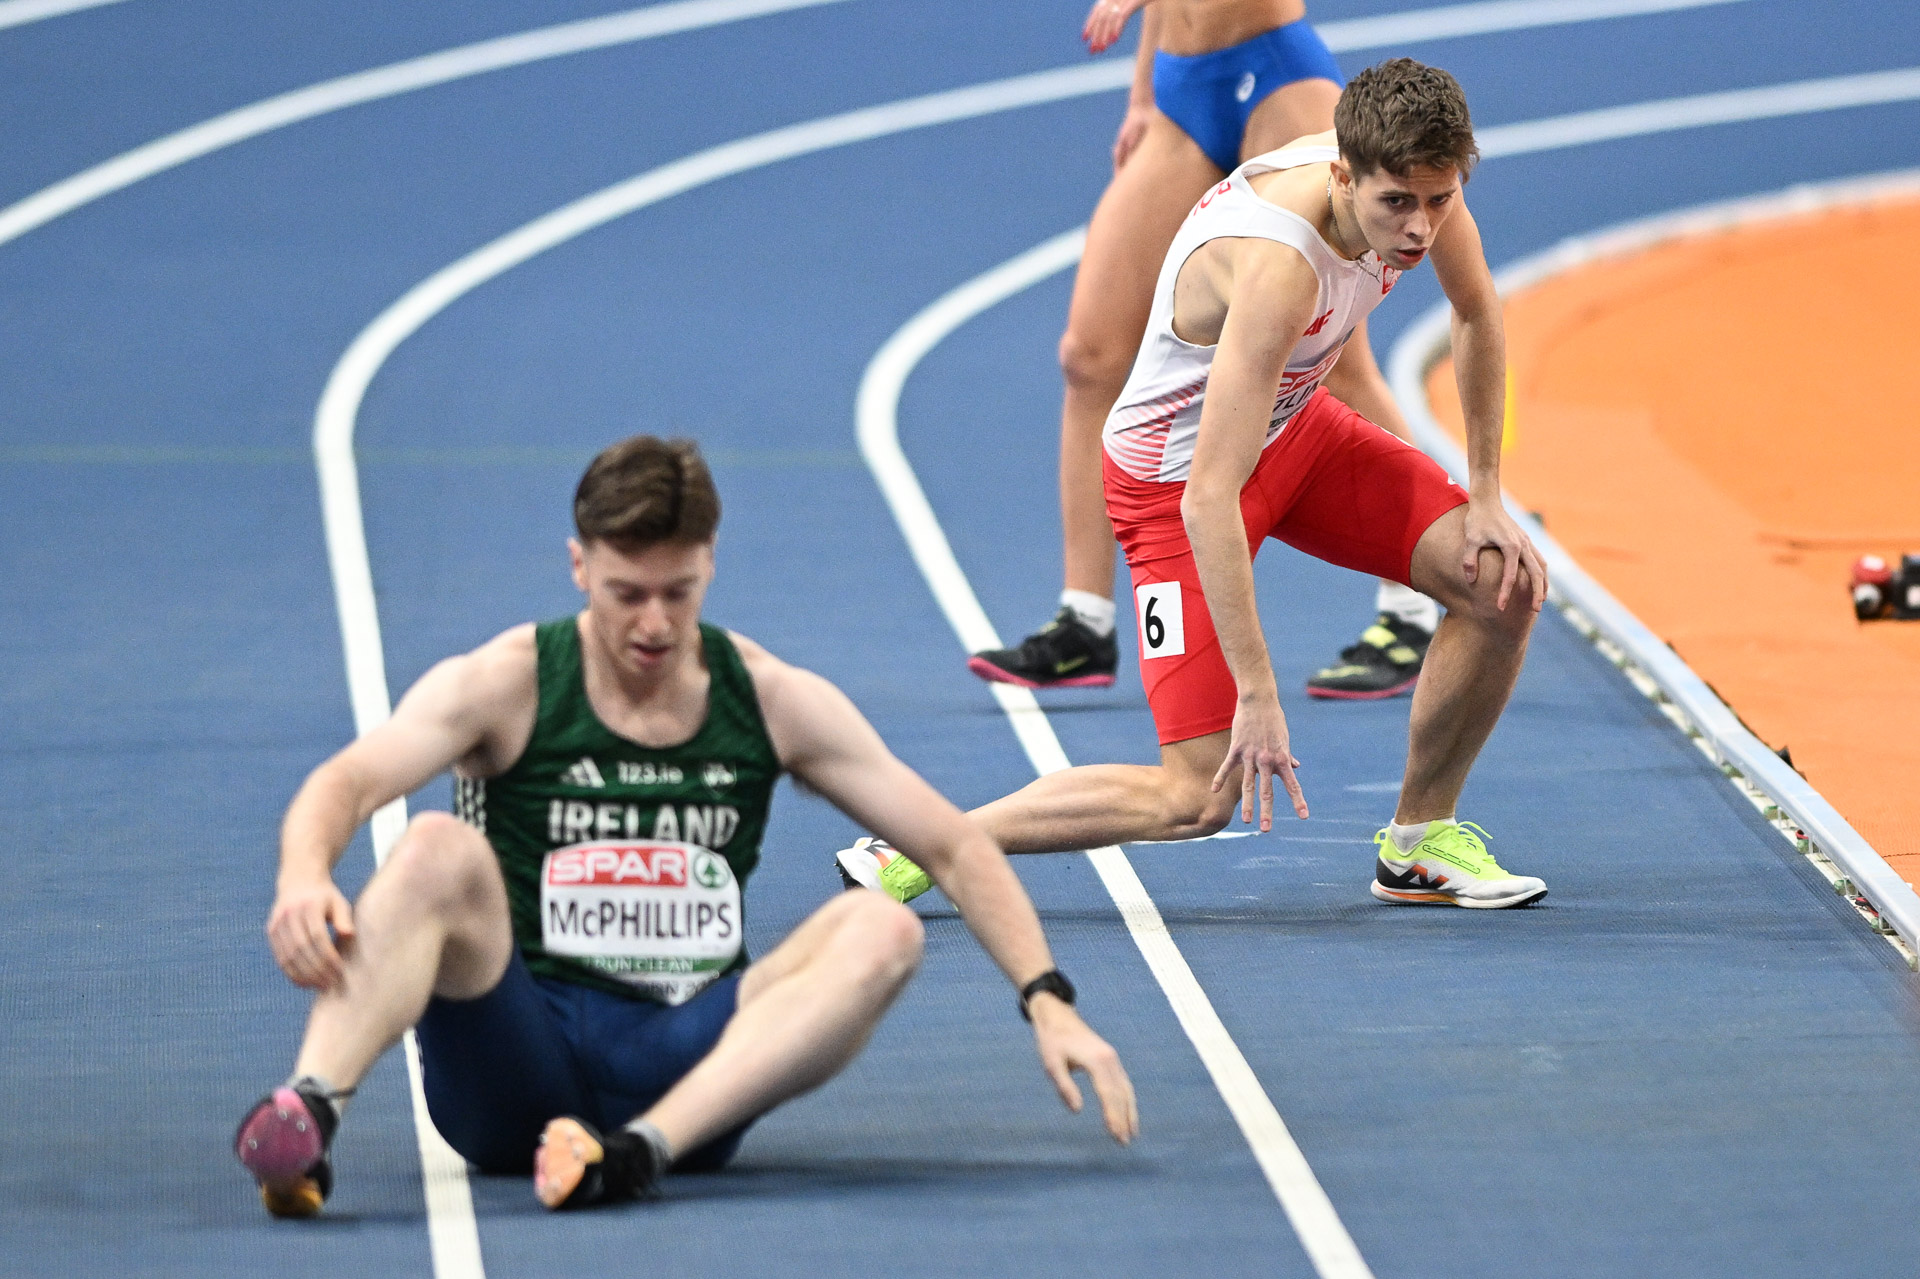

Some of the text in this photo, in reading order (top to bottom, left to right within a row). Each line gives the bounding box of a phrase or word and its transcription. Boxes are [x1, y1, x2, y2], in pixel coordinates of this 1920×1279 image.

[1145, 596, 1165, 649] 6
[548, 799, 740, 849] IRELAND
[552, 850, 687, 884] SPAR
[549, 900, 733, 939] McPHILLIPS
